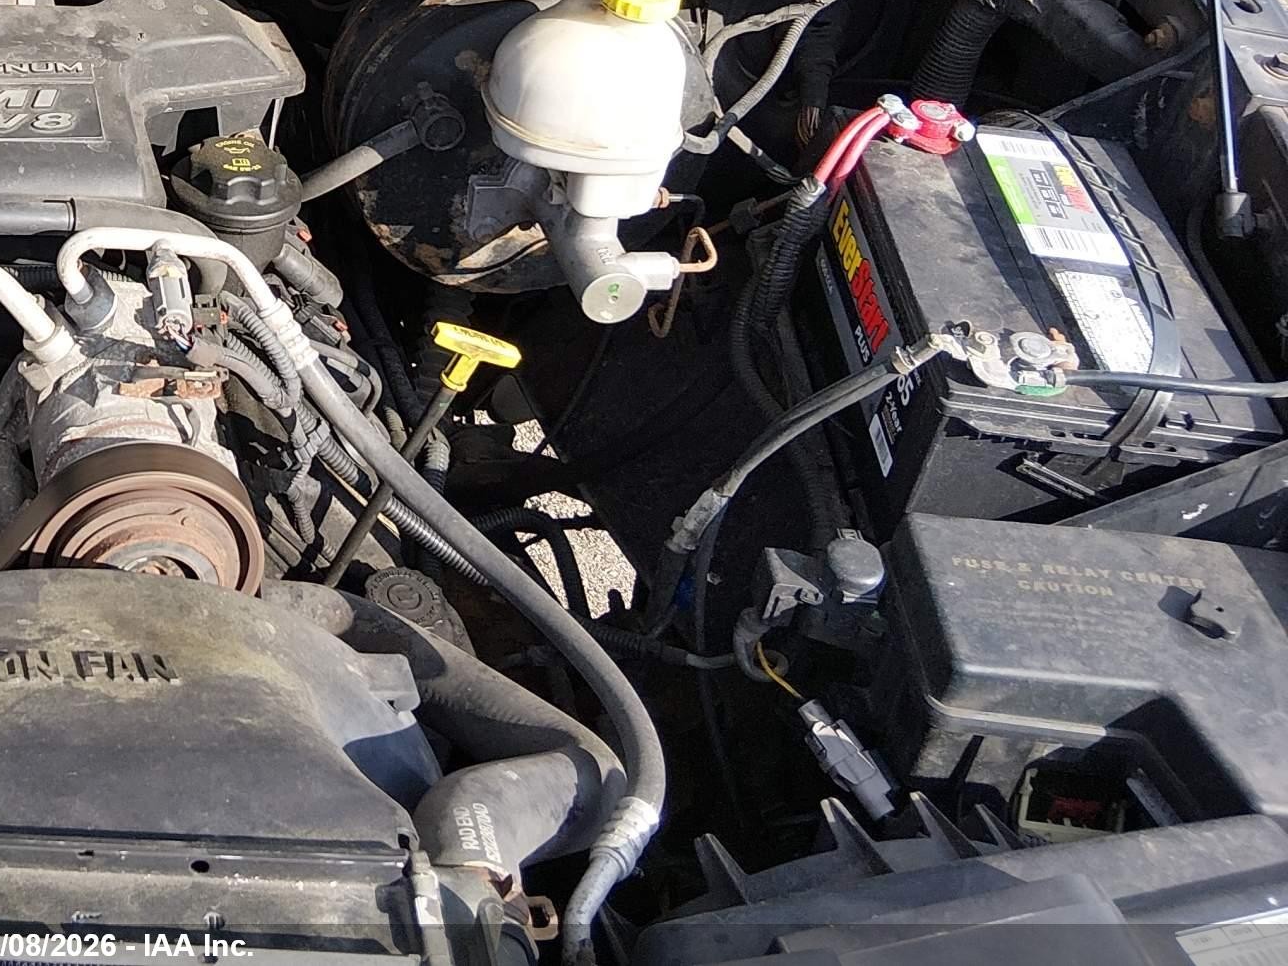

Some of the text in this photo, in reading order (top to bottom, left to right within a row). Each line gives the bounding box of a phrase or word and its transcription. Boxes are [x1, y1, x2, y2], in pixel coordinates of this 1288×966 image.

[831, 199, 890, 354] EverStart
[853, 324, 872, 365] PLUS
[951, 556, 1012, 573] FUSE
[1041, 563, 1112, 580] RELAY
[1118, 570, 1206, 590] CENTER
[1016, 579, 1114, 598] CAUTION
[72, 650, 182, 685] FAN
[453, 805, 481, 852] RAD END
